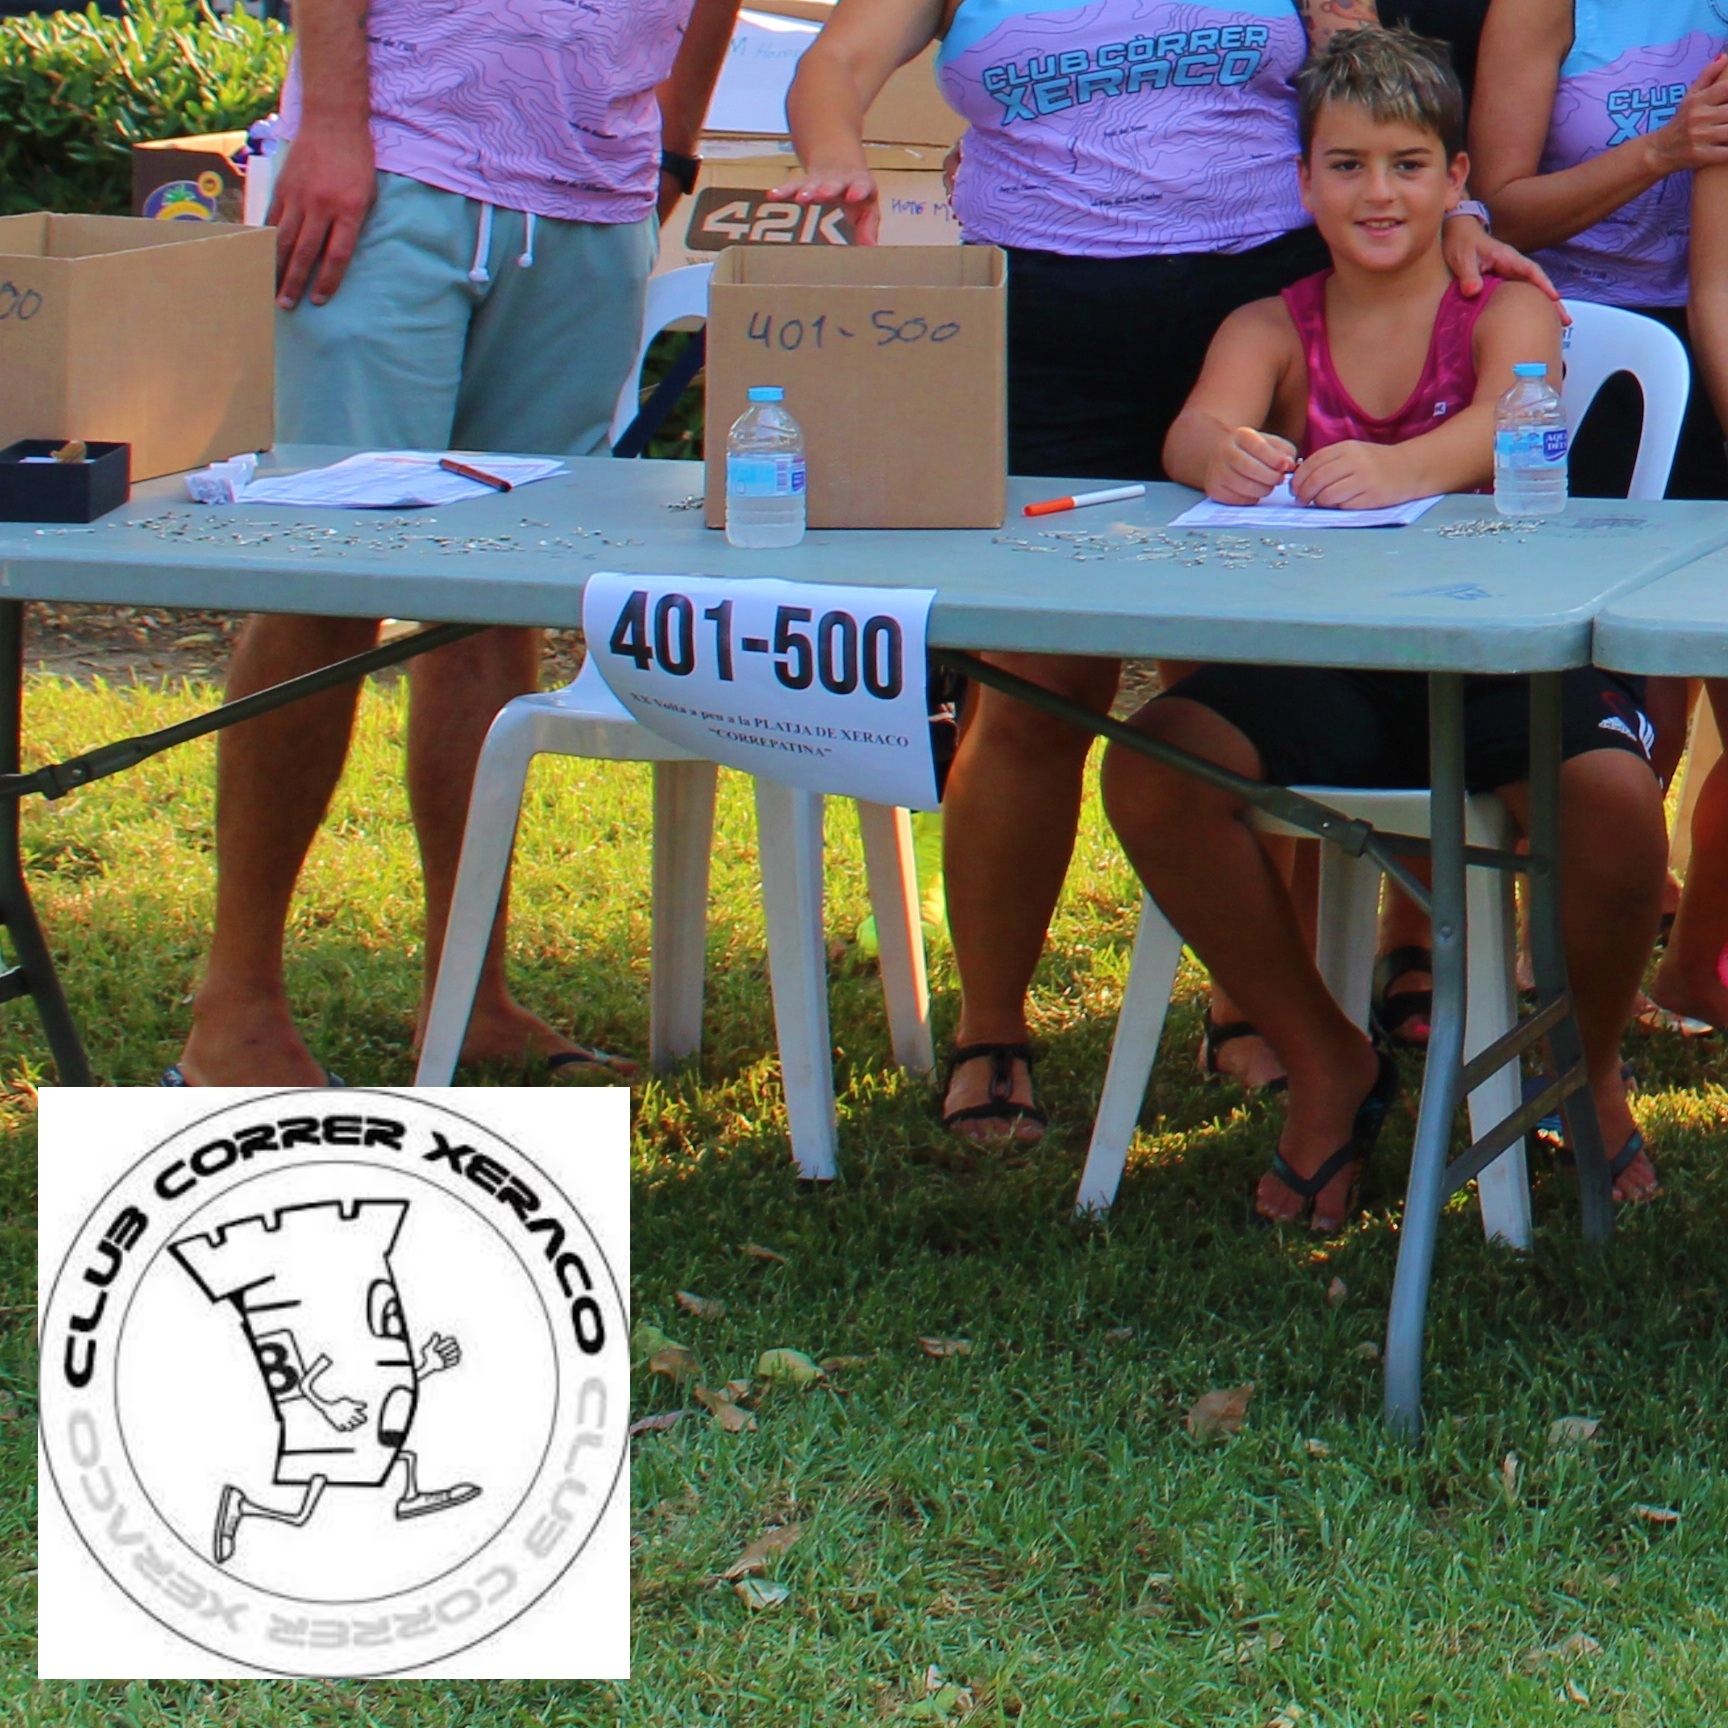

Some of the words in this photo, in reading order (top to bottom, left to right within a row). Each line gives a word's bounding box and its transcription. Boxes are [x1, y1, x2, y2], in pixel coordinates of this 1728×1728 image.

[983, 49, 1091, 92] CLUB
[989, 48, 1264, 127] XERACO
[702, 200, 848, 245] 42K
[609, 589, 903, 700] 401-500
[654, 695, 688, 716] Volta
[689, 708, 698, 717] a
[701, 710, 725, 724] peu
[727, 715, 736, 724] a
[738, 715, 751, 727] la
[754, 717, 812, 738] PLATJA
[815, 726, 837, 740] DE
[840, 729, 909, 748] XERACO
